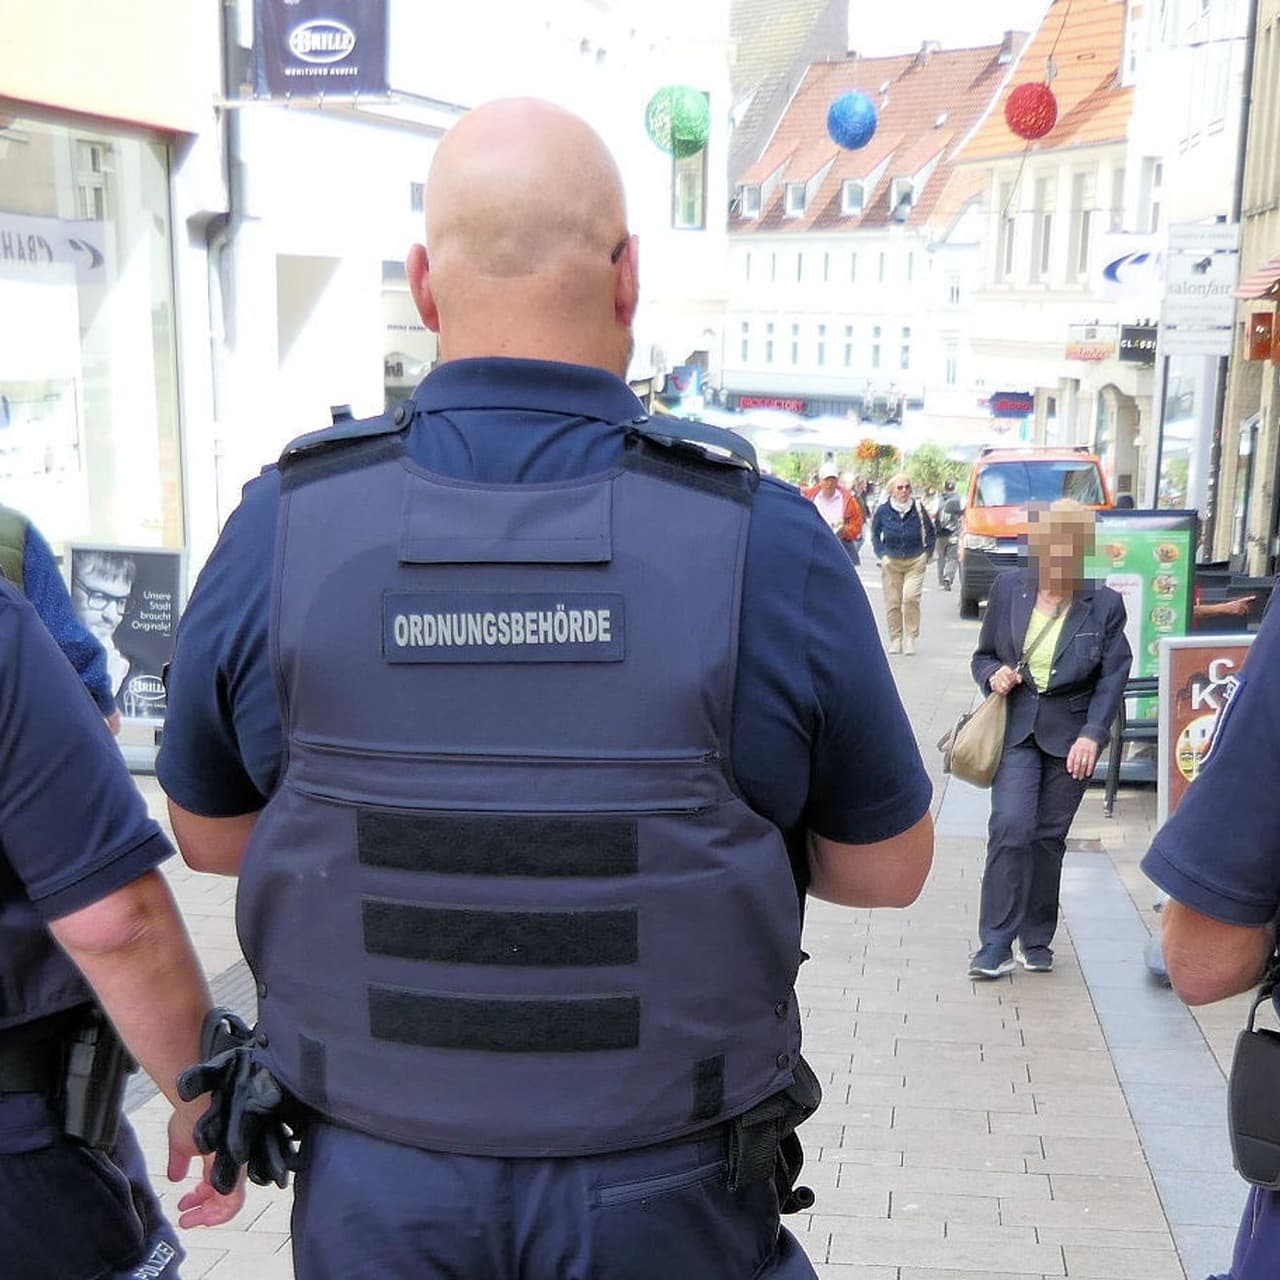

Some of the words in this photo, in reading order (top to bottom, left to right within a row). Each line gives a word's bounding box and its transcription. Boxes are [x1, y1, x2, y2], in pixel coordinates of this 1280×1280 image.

[143, 591, 171, 600] Unsere
[150, 601, 171, 610] Stadt
[140, 611, 171, 620] braucht
[131, 620, 171, 632] Originale!
[394, 604, 612, 647] ORDNUNGSBEHÖRDE
